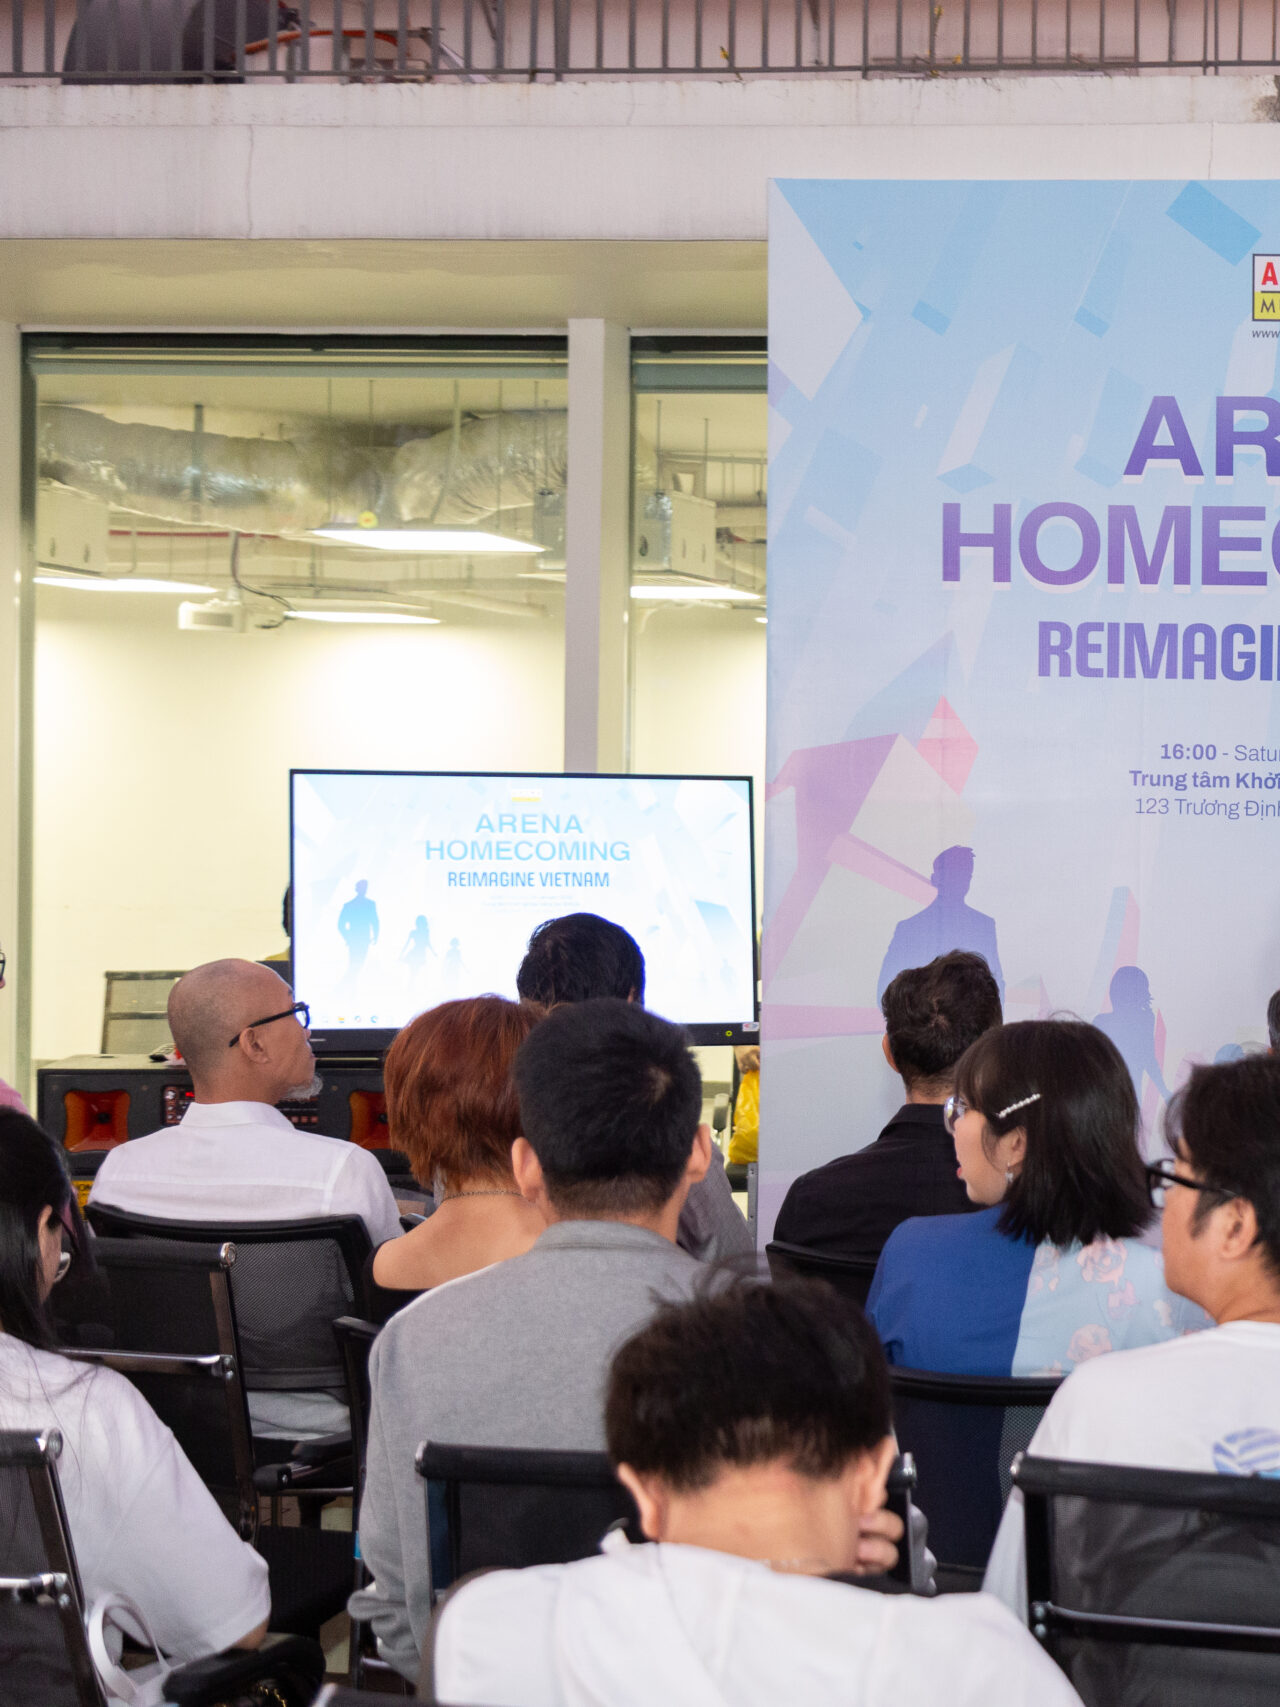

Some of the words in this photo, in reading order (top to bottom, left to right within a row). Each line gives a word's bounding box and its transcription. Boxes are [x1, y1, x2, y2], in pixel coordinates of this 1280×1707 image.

[1161, 743, 1217, 761] 16:00
[1129, 769, 1188, 791] Trung
[1192, 770, 1230, 788] tâm
[1236, 771, 1280, 790] Khởi
[1135, 797, 1169, 815] 123
[1174, 798, 1240, 820] Trương
[475, 813, 584, 834] ARENA
[425, 840, 631, 862] HOMECOMING
[448, 871, 535, 887] REIMAGINE
[539, 872, 610, 888] VIETNAM
